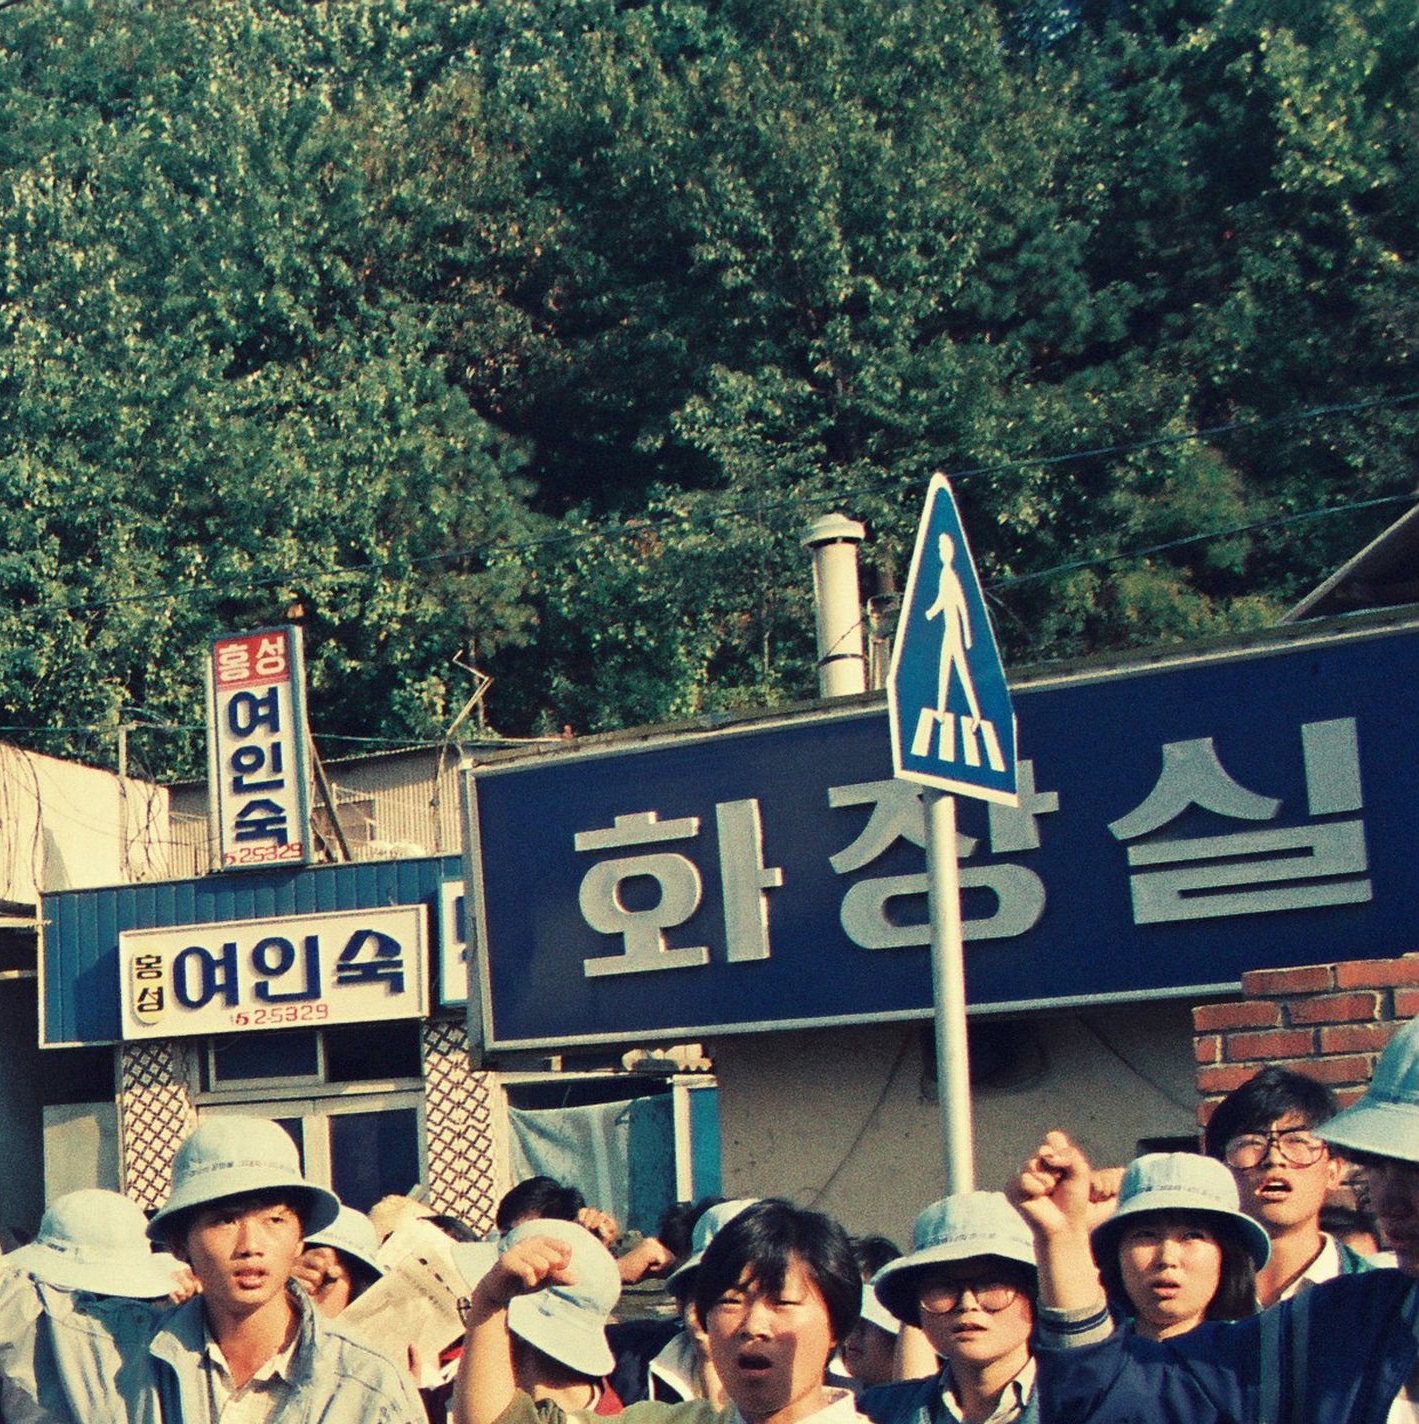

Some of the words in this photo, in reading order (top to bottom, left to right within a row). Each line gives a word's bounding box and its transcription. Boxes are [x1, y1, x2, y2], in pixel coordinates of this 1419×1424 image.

[219, 636, 285, 682] 홍성
[227, 684, 289, 846] 여인숙
[574, 717, 1372, 978] 화장실
[136, 954, 163, 1013] 홍성
[172, 929, 405, 1010] 여인숙
